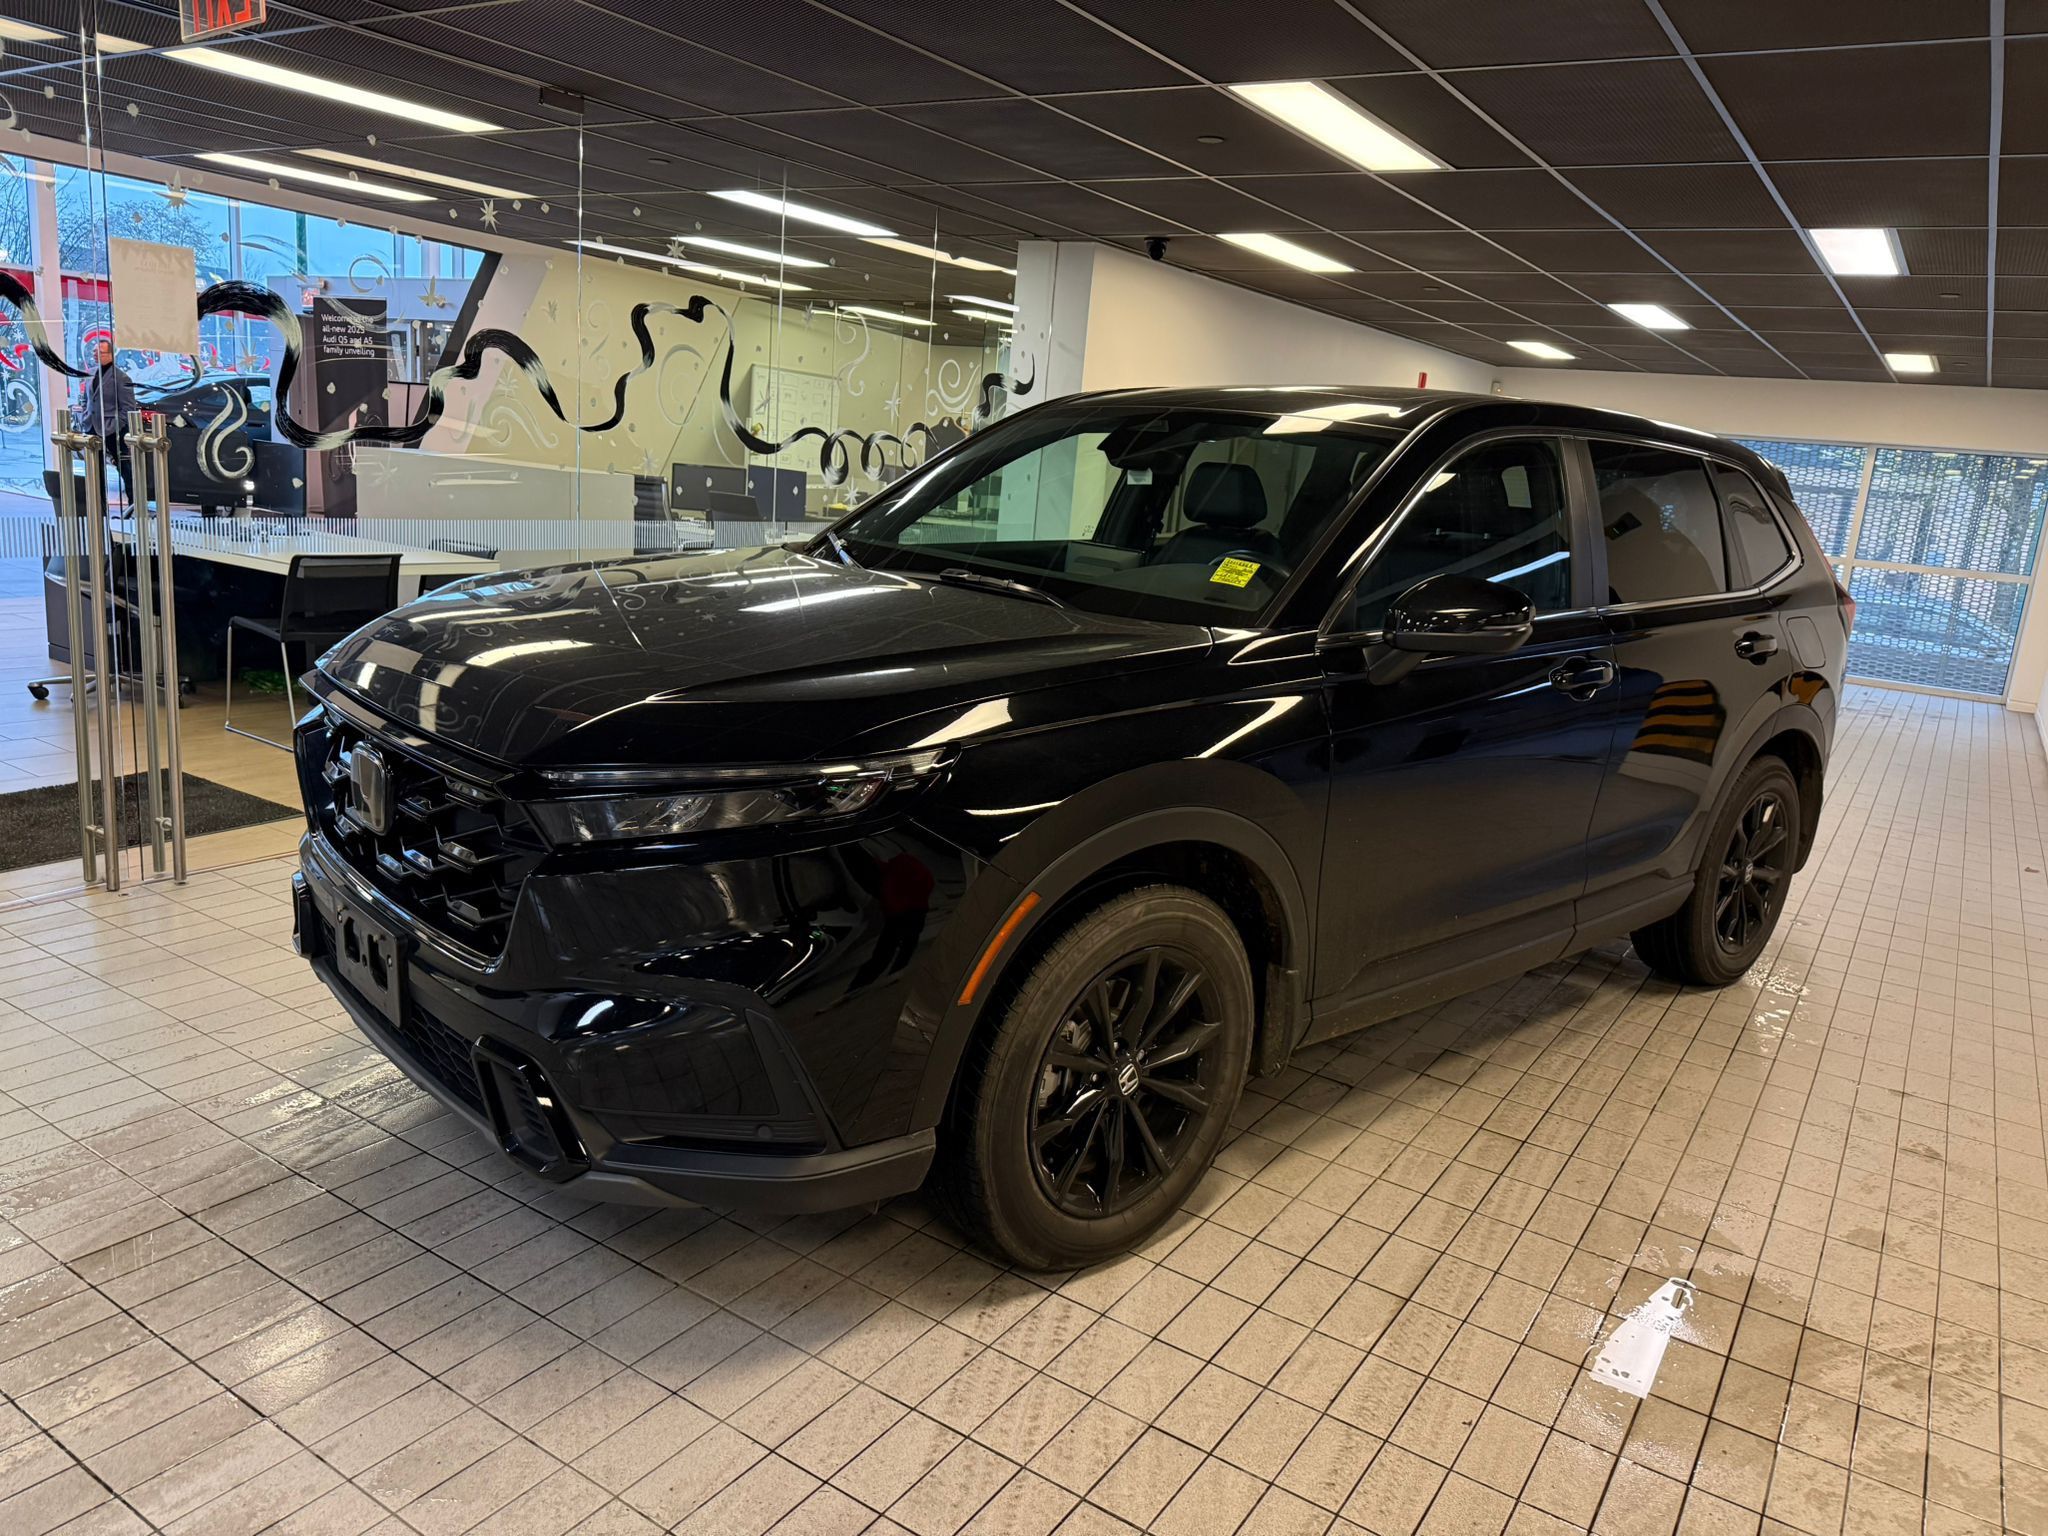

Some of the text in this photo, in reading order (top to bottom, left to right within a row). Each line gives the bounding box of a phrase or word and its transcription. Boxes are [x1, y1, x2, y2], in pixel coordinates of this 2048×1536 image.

[322, 324, 365, 334] all-new 2025
[323, 335, 337, 343] Audi
[337, 335, 348, 344] Q5
[363, 336, 373, 345] A5
[323, 345, 375, 358] family unveiling
